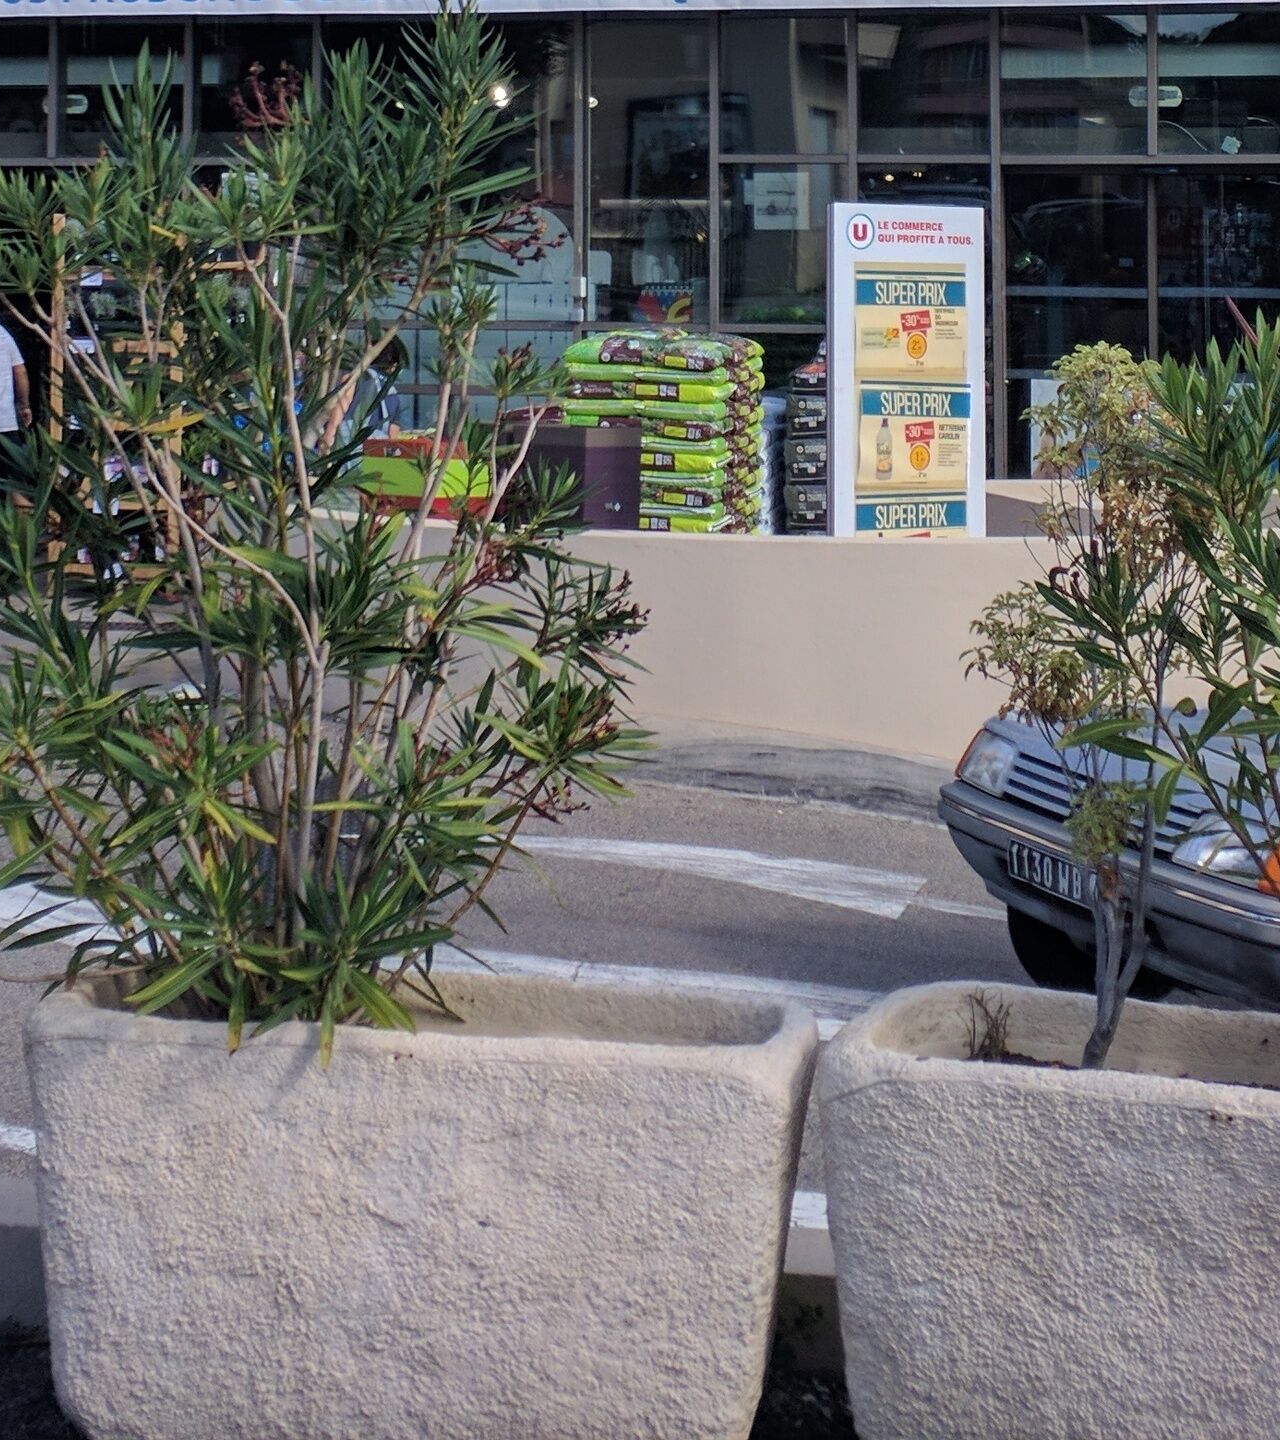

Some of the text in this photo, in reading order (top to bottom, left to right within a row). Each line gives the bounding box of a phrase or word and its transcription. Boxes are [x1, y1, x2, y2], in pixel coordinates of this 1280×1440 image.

[853, 221, 944, 241] U LE COMMERCE
[877, 234, 895, 243] QUI
[897, 234, 936, 244] PROFITE
[947, 236, 974, 246] TOUS.
[875, 281, 948, 305] SUPER PRIX
[880, 392, 952, 417] SUPER PRIX
[875, 503, 948, 529] SUPER PRIX
[1011, 843, 1053, 889] 1130
[1058, 861, 1082, 900] WB
